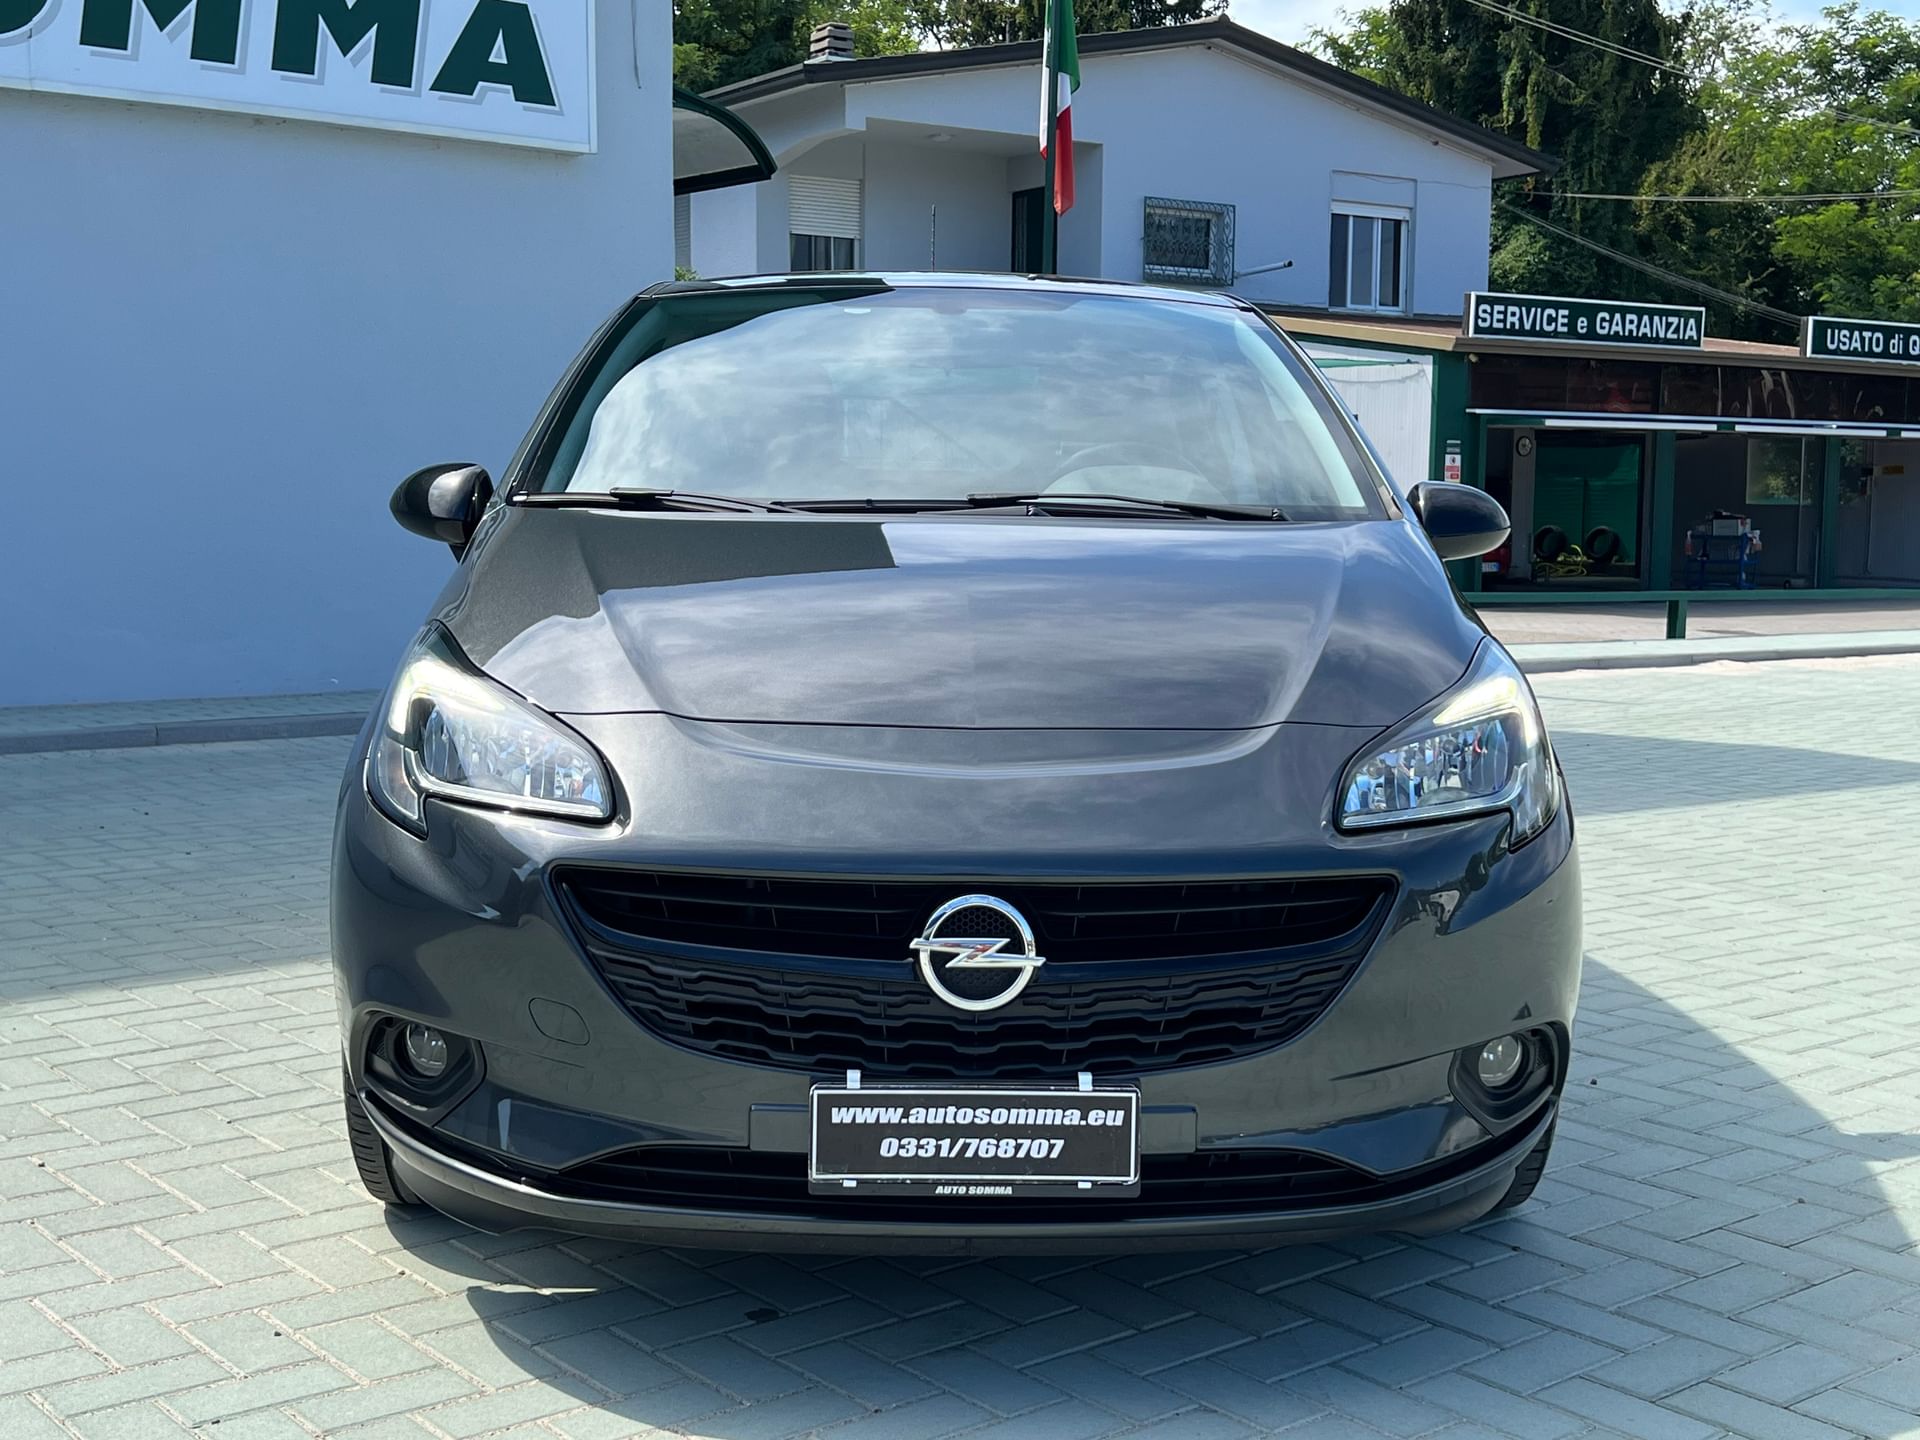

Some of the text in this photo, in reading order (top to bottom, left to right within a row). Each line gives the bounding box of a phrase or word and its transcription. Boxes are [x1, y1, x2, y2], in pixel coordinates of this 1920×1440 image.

[1477, 303, 1698, 340] SERVICE e GARANZIA
[1826, 328, 1884, 353] USATO
[1889, 333, 1904, 355] di
[831, 1105, 1125, 1127] www.autosomma.eu
[880, 1136, 1065, 1159] 0331/768707
[935, 1185, 1013, 1196] AUTO SOMMA
